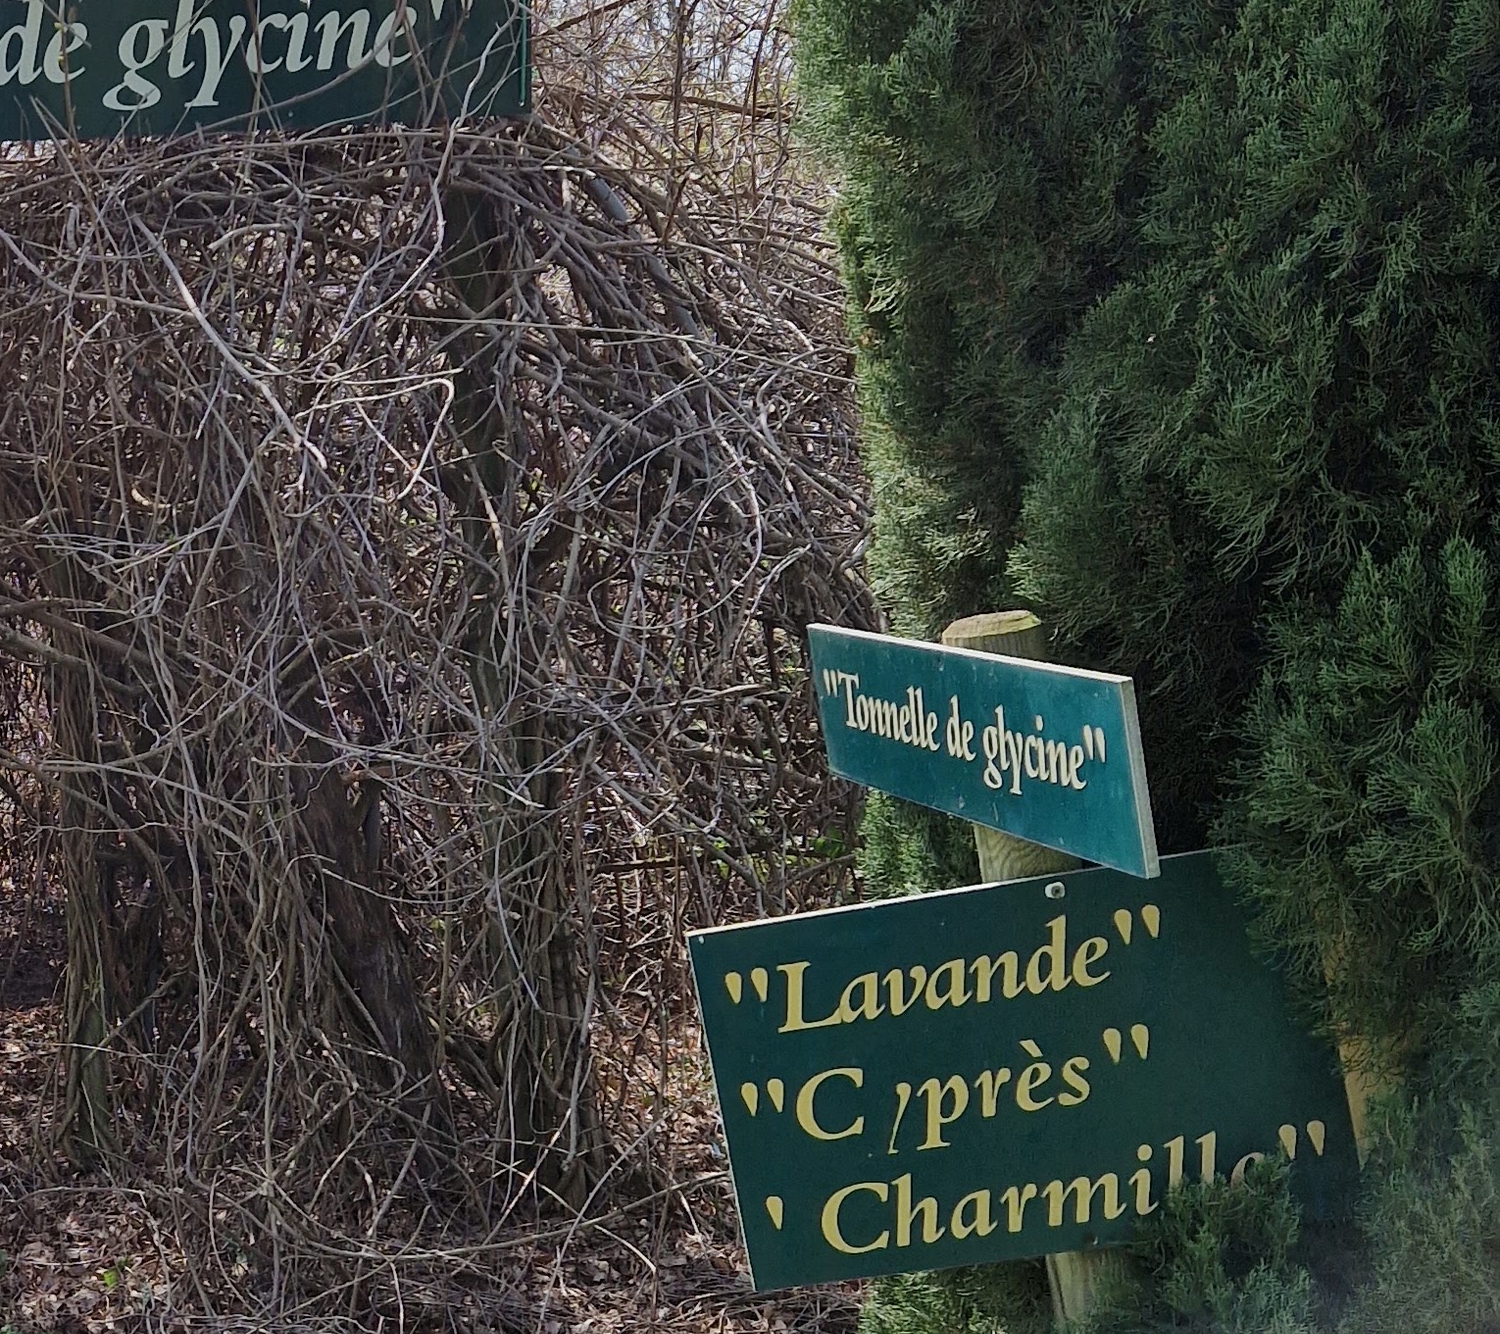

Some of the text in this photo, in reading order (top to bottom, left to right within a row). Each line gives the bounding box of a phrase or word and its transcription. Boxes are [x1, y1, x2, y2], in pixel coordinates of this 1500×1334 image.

[823, 668, 1106, 795] "Tonnelle de glycine"
[725, 904, 1161, 1034] "Lavande"
